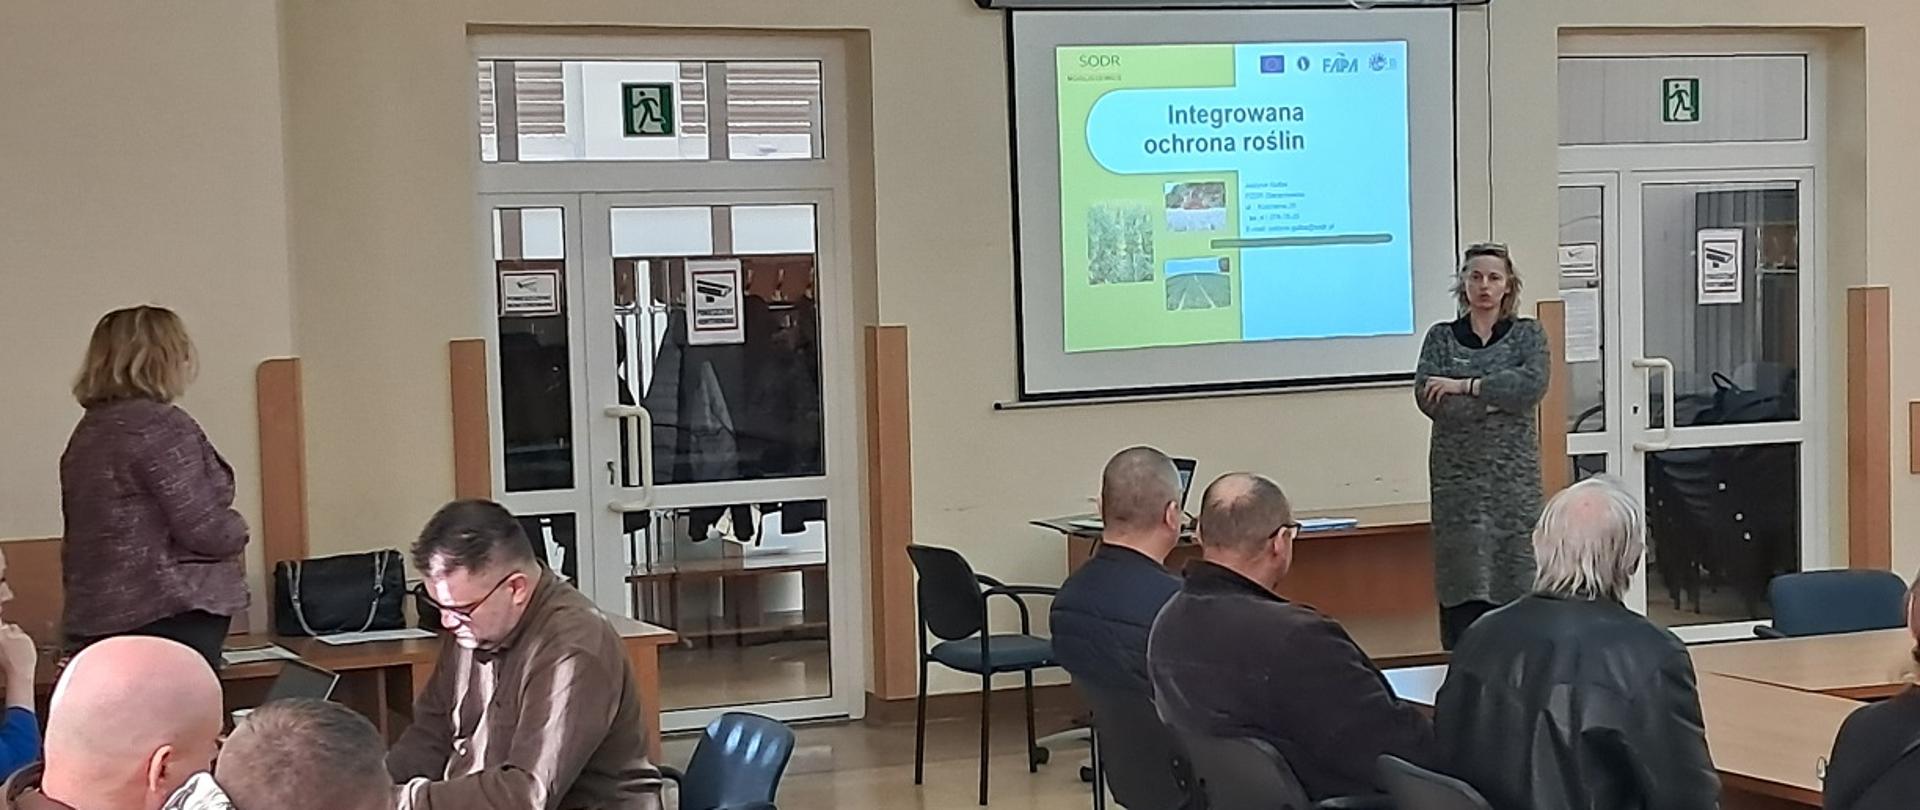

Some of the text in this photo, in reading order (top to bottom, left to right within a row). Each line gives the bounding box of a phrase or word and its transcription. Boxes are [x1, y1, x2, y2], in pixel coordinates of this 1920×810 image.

[1168, 104, 1304, 129] Integrowana
[1144, 129, 1305, 154] ochrona roślin
